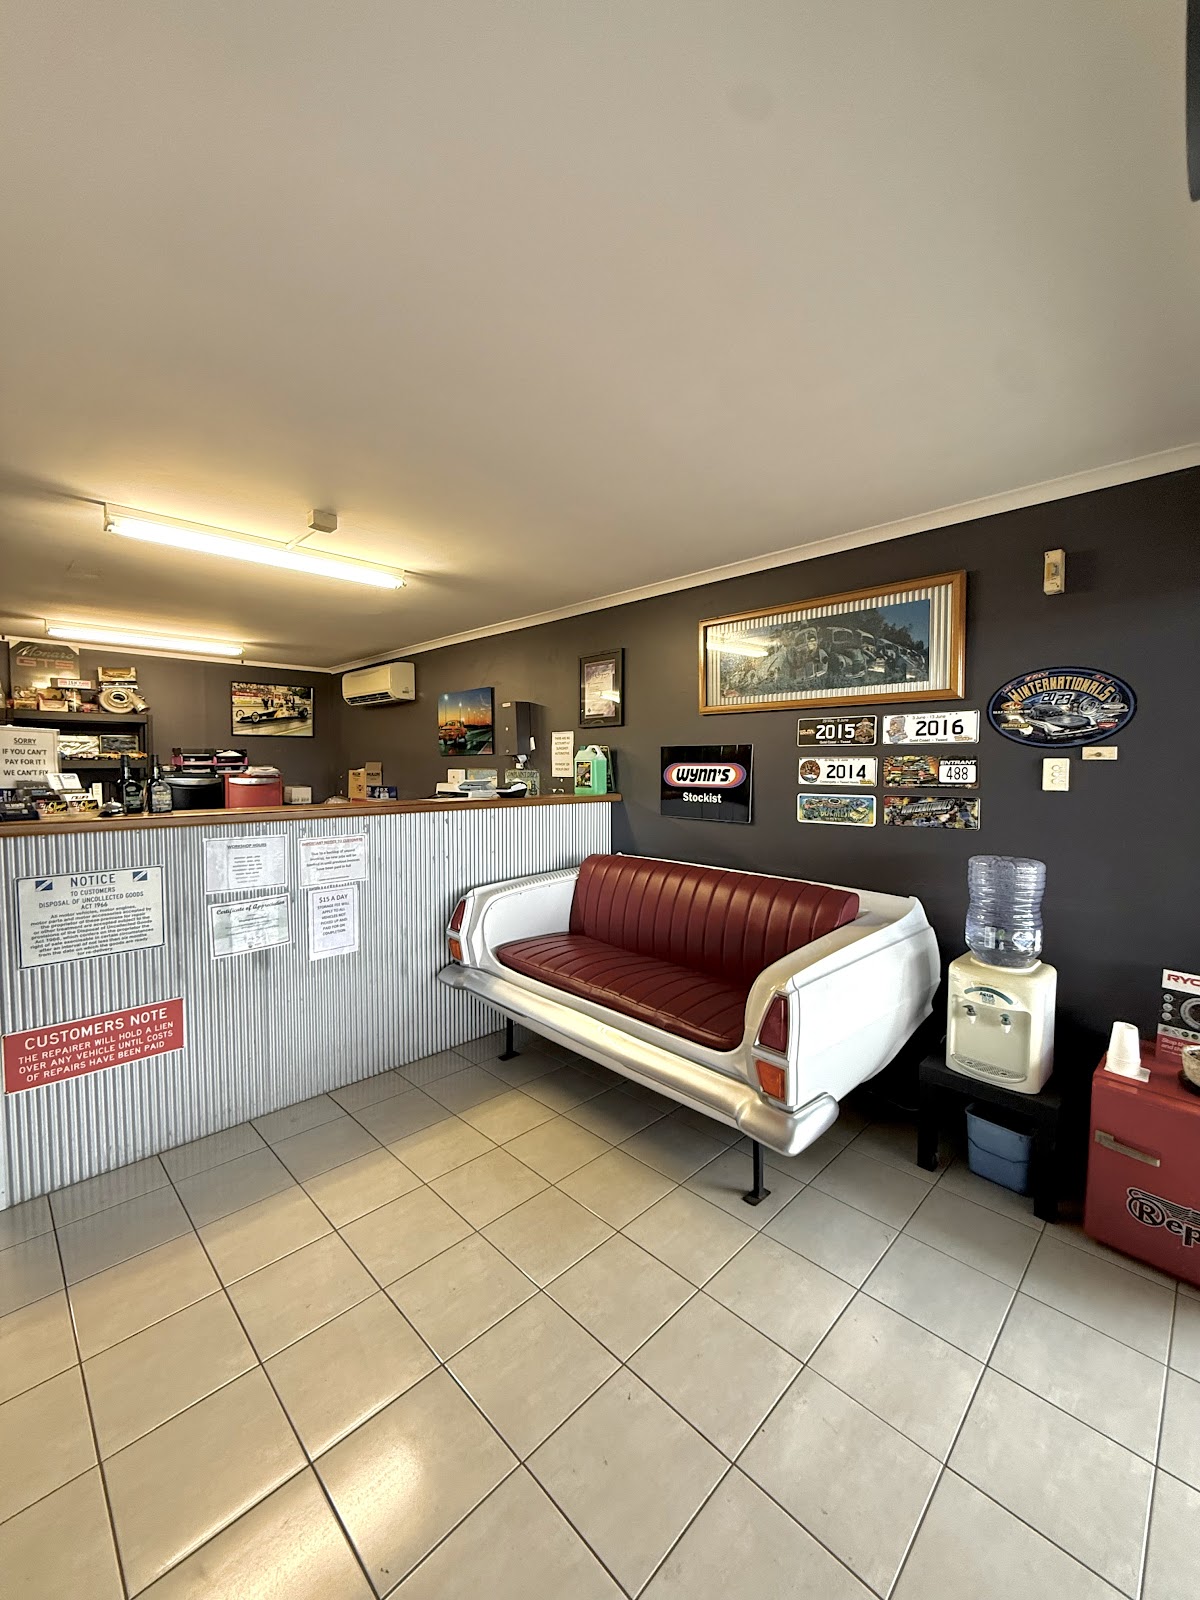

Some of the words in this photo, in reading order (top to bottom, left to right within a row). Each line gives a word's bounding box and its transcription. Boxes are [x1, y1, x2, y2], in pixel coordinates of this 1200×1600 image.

[16, 656, 74, 669] GTS
[1008, 676, 1116, 702] WINTERNATIONALS
[816, 723, 855, 739] 2015
[916, 719, 963, 736] 2016
[827, 764, 866, 778] 2014
[947, 767, 968, 780] 488
[683, 792, 722, 803] Stockist
[70, 874, 116, 888] NOTICE
[80, 887, 116, 896] CUSTOMERS
[82, 894, 124, 903] UNCOLLECTED
[216, 907, 244, 916] Certificate
[253, 900, 285, 910] Appreciation
[24, 1018, 124, 1050] CUSTOMERS
[130, 1008, 167, 1027] NOTE
[18, 1054, 38, 1065] THE
[42, 1042, 91, 1059] REPAIRER
[94, 1036, 116, 1046] WILL
[119, 1029, 142, 1041] HOLD
[154, 1021, 174, 1032] LIEN
[18, 1063, 47, 1074] OVER
[51, 1056, 72, 1067] ANY
[76, 1045, 116, 1060] VEHICLE
[119, 1038, 143, 1050] UNTIL
[147, 1031, 173, 1042] COSTS
[26, 1073, 39, 1082] OF
[44, 1062, 86, 1078] REPAIRS
[89, 1054, 115, 1066] HAVE
[118, 1047, 141, 1059] BEEN
[144, 1041, 165, 1052] PAID
